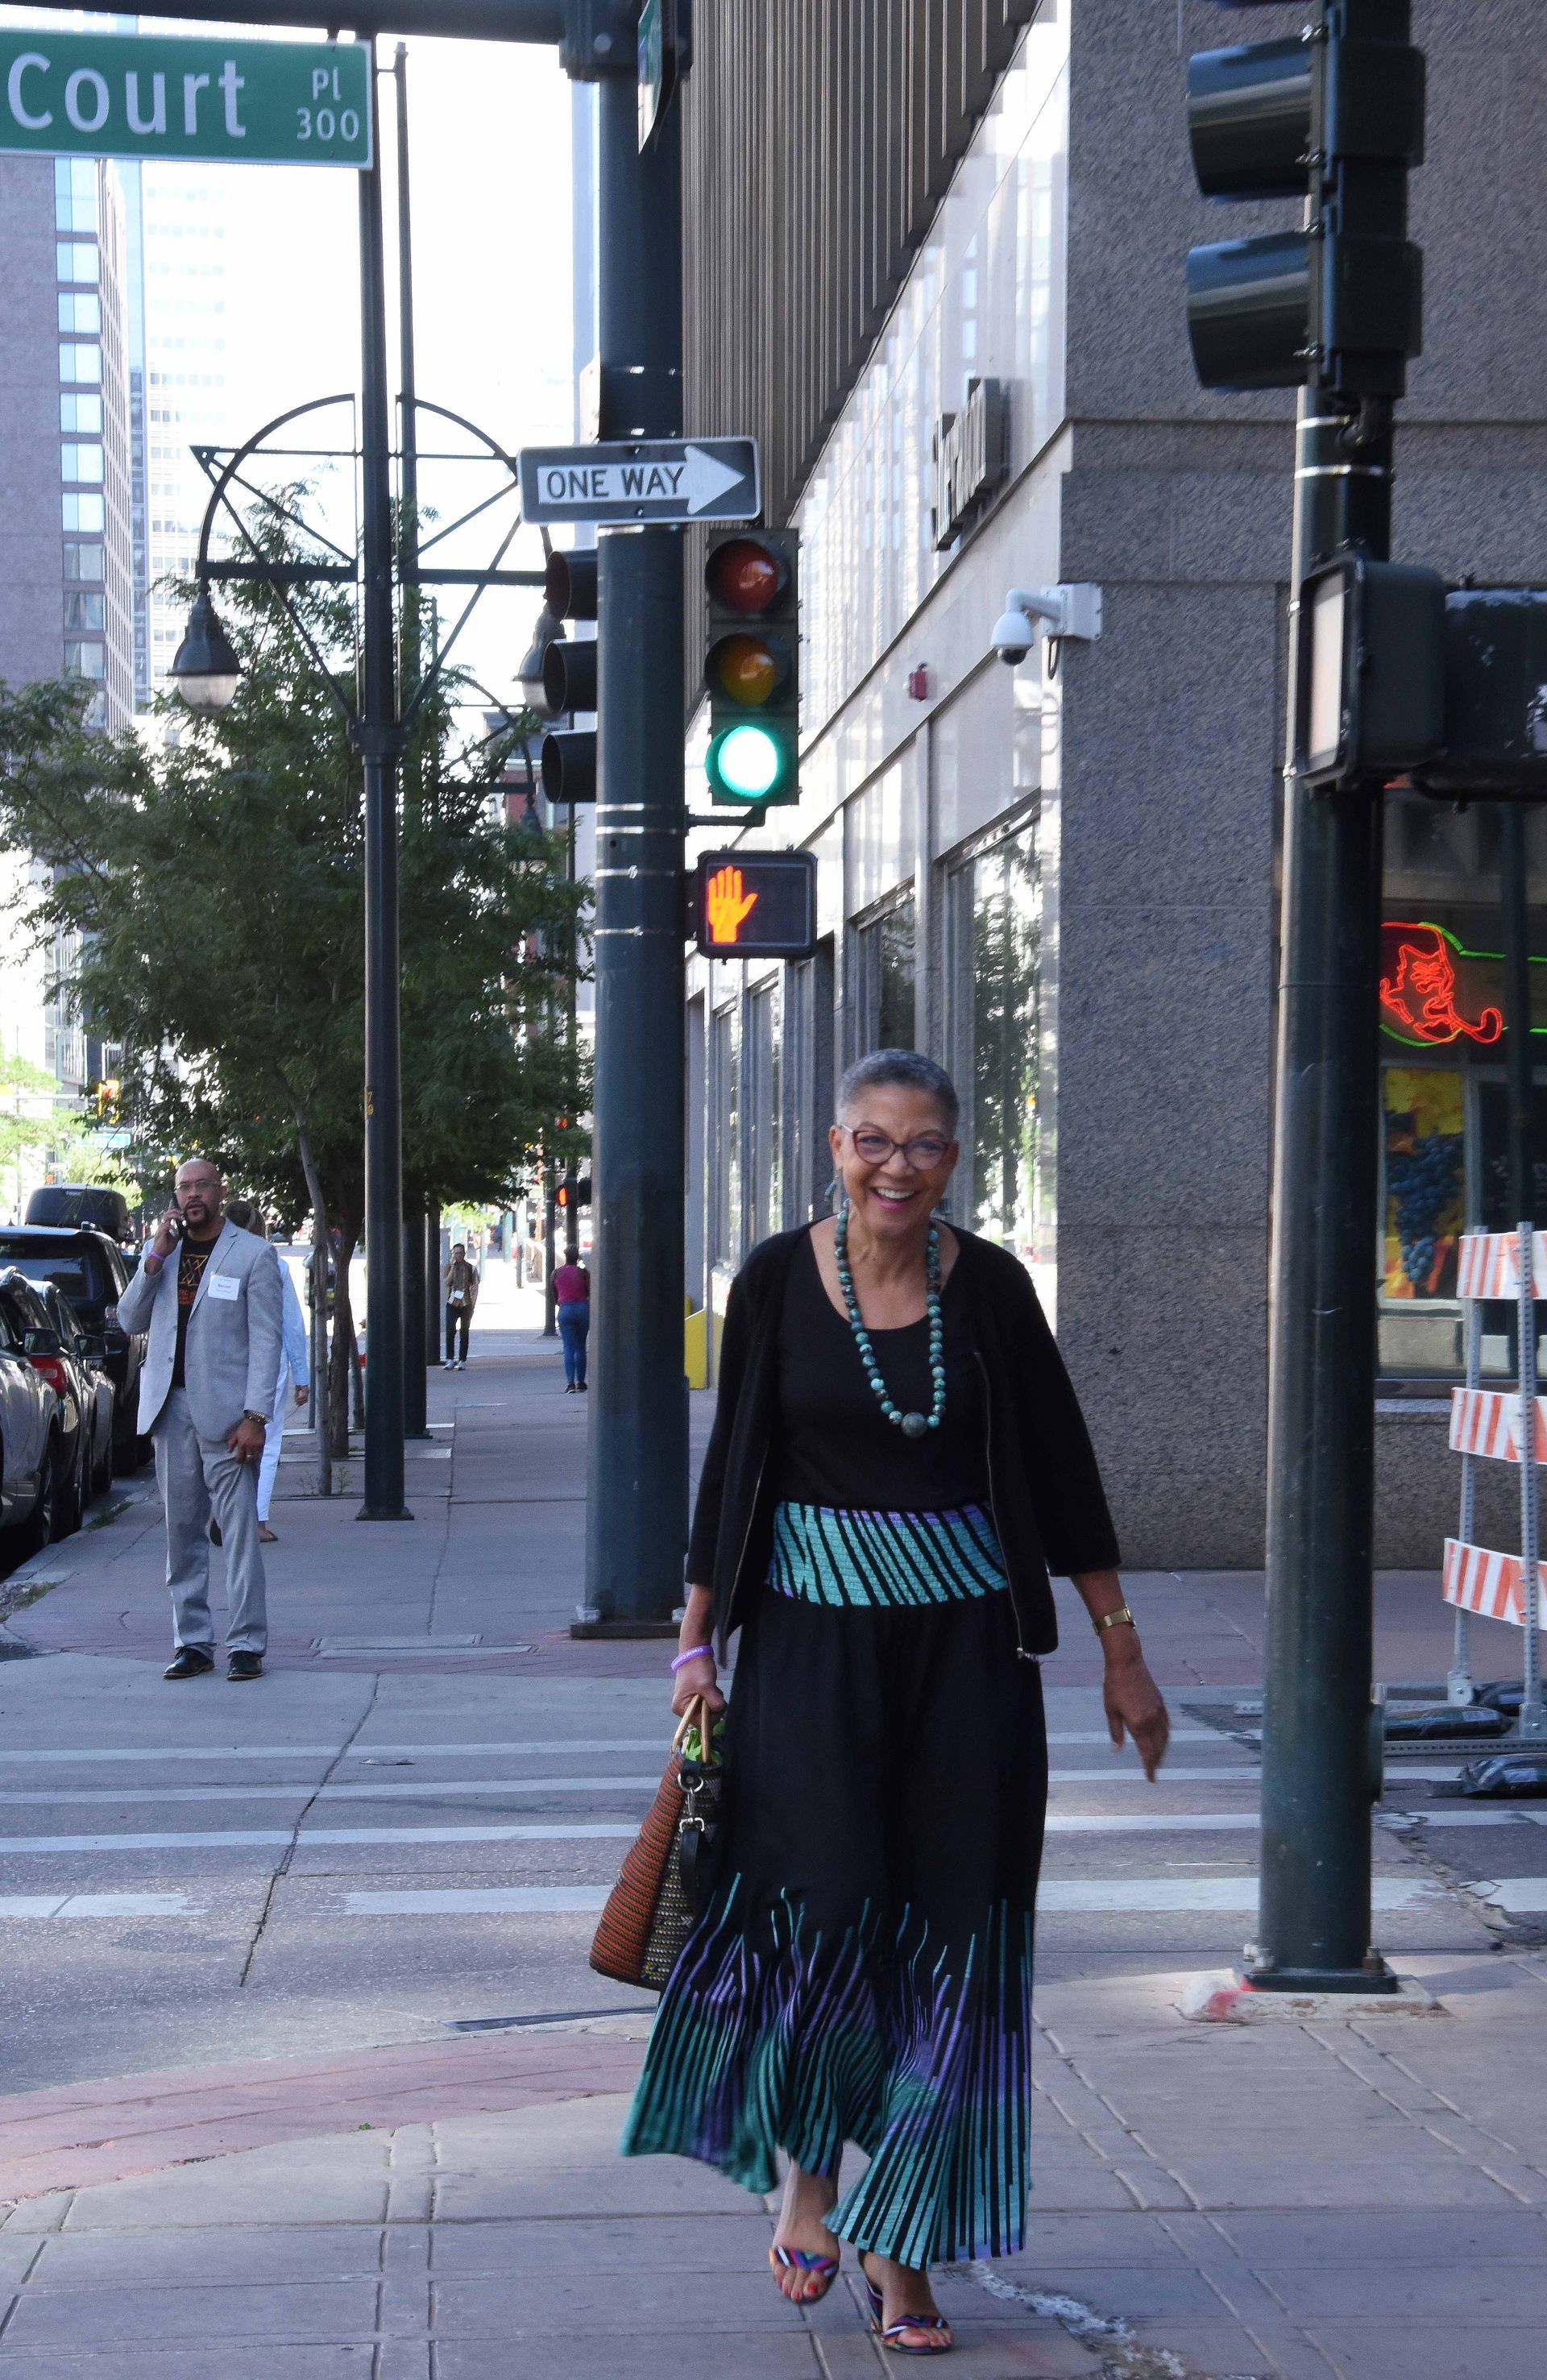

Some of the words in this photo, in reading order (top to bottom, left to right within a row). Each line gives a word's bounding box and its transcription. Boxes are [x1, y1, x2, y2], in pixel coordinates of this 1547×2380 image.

[7, 52, 246, 137] Court
[312, 66, 341, 101] Pl
[296, 107, 359, 142] 300
[546, 467, 609, 499] ONE
[620, 463, 685, 498] WAY
